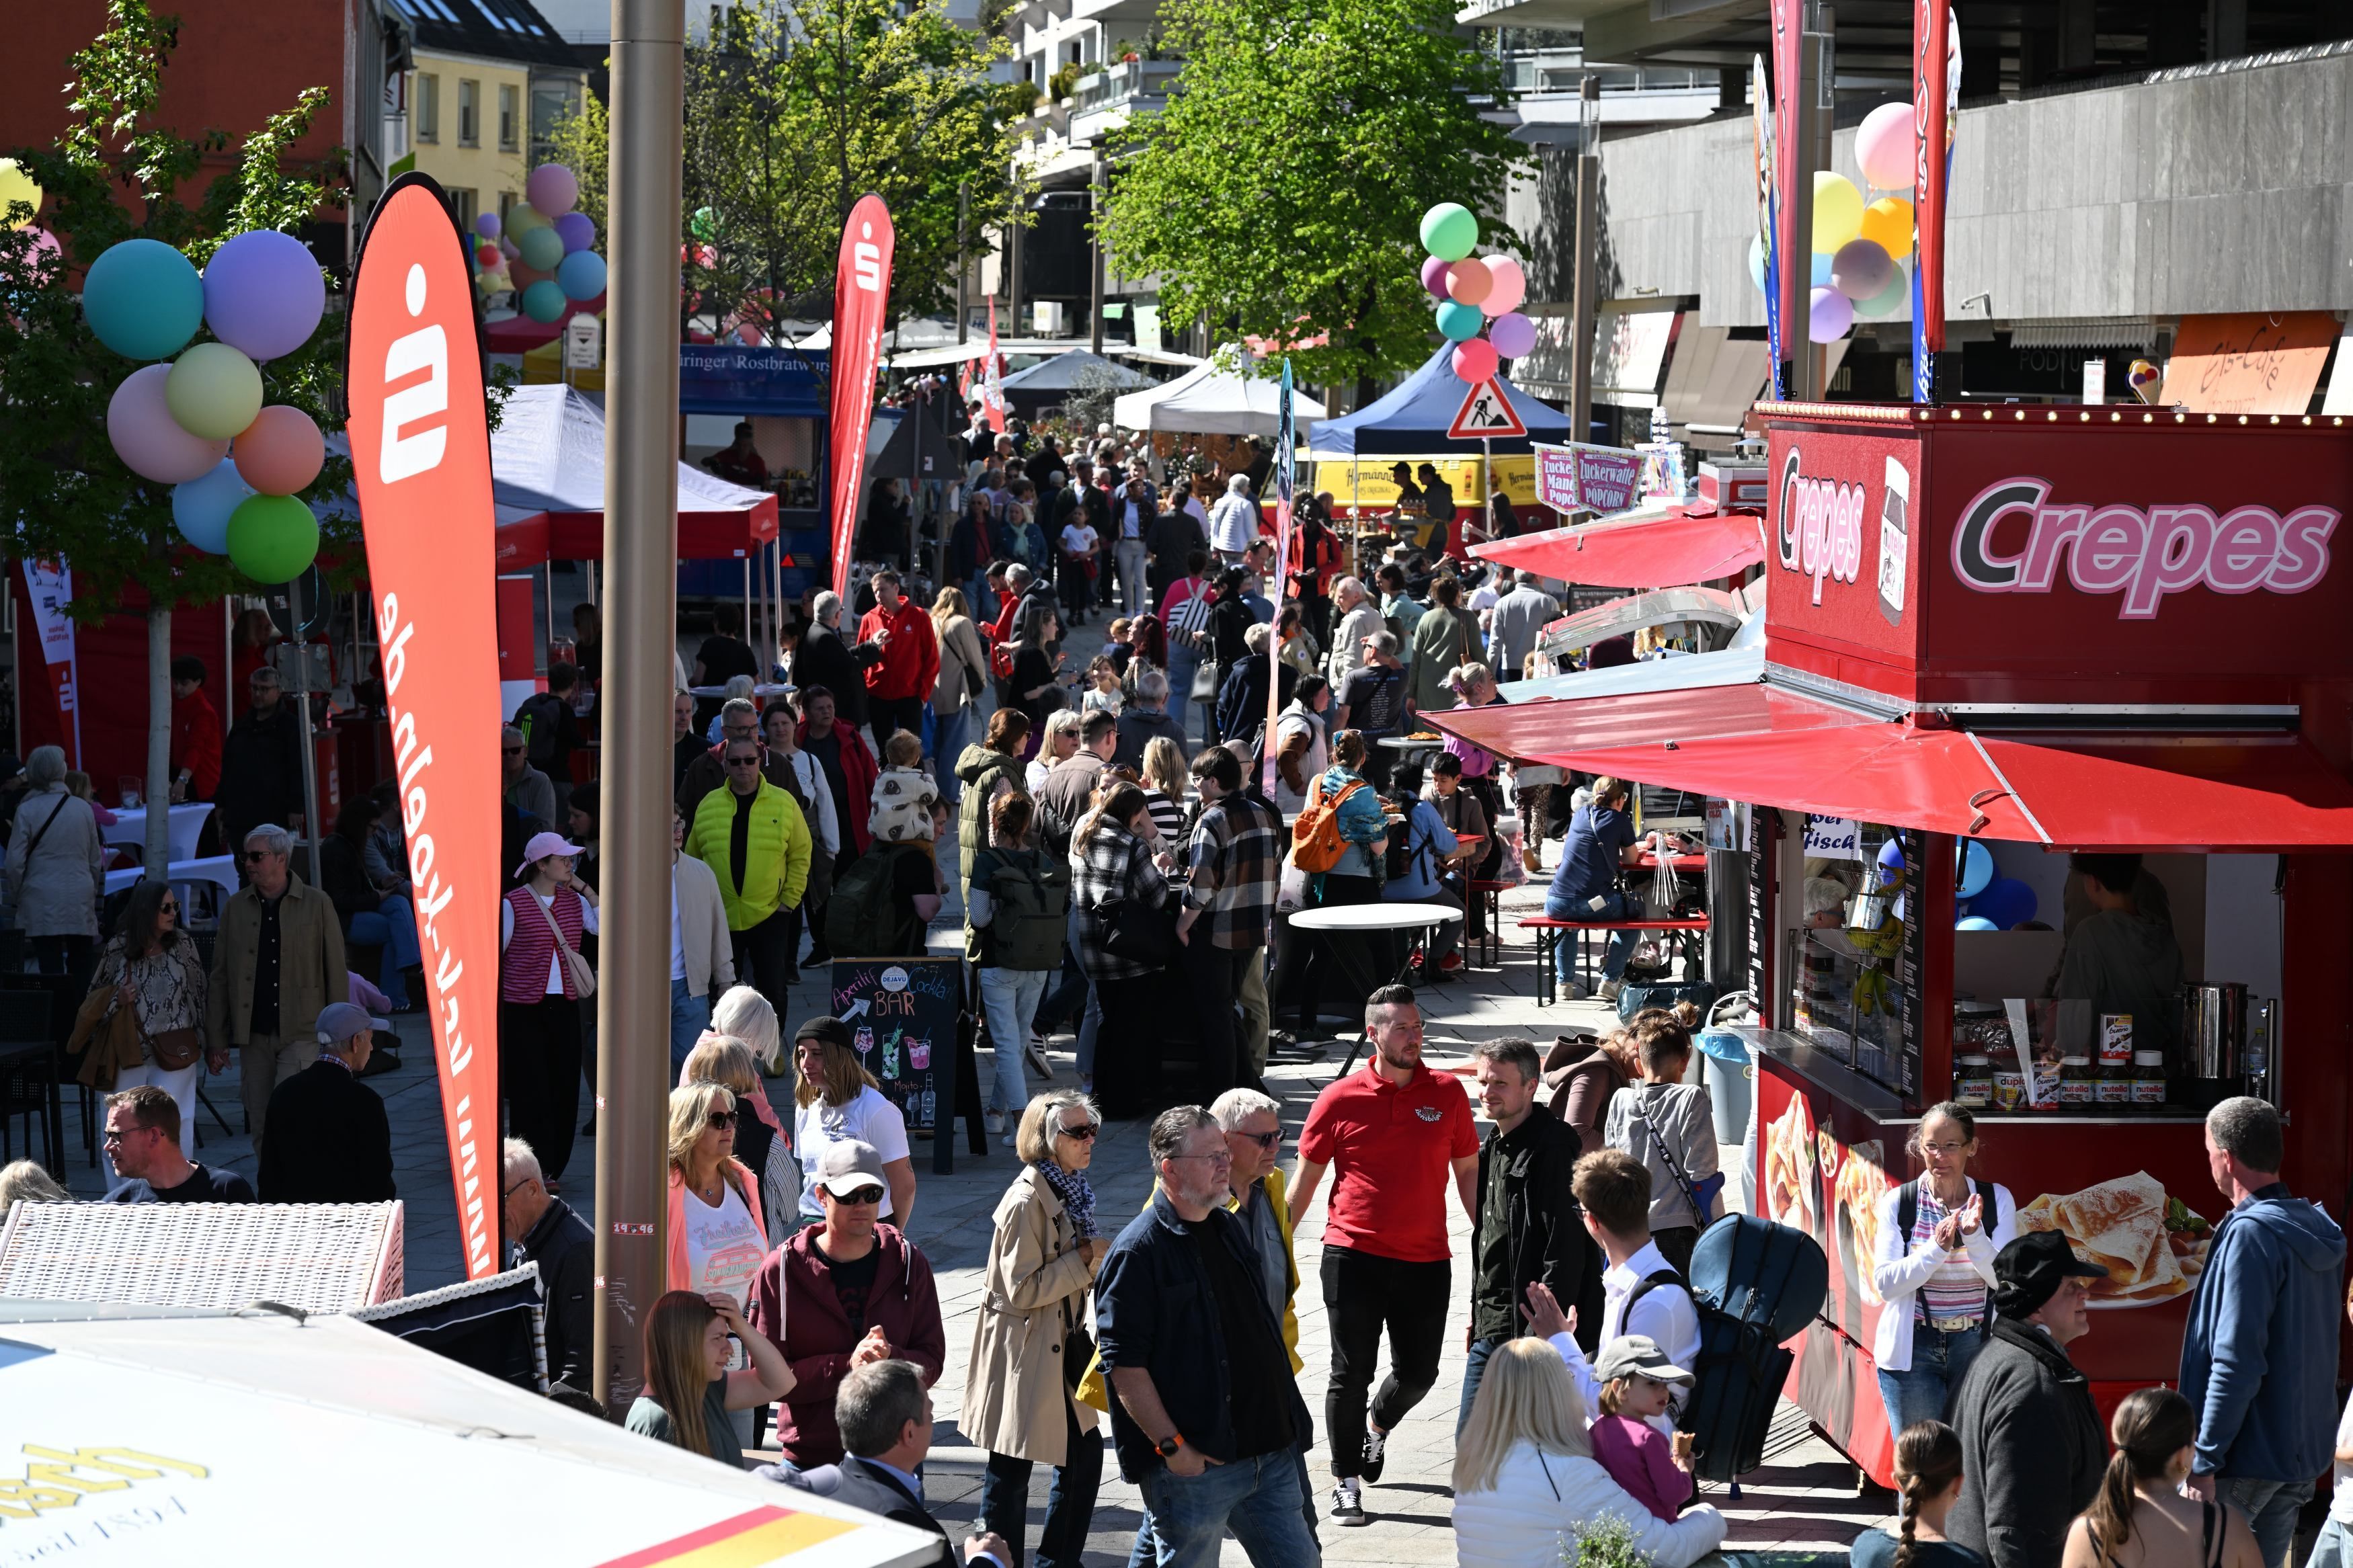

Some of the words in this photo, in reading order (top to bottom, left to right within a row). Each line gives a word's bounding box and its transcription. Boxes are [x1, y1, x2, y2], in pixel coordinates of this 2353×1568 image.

[1579, 458, 1636, 486] Zuckerwatte
[1585, 487, 1626, 508] POPCORN
[1778, 444, 1866, 608] Crepes
[1950, 474, 2344, 620] Crepes
[832, 966, 878, 1011] Aperitif
[907, 966, 957, 1002] Cocktail
[874, 991, 916, 1017] BAR
[894, 1081, 919, 1094] Mojito
[2102, 1085, 2128, 1093] nutella
[2136, 1085, 2163, 1093] nutella
